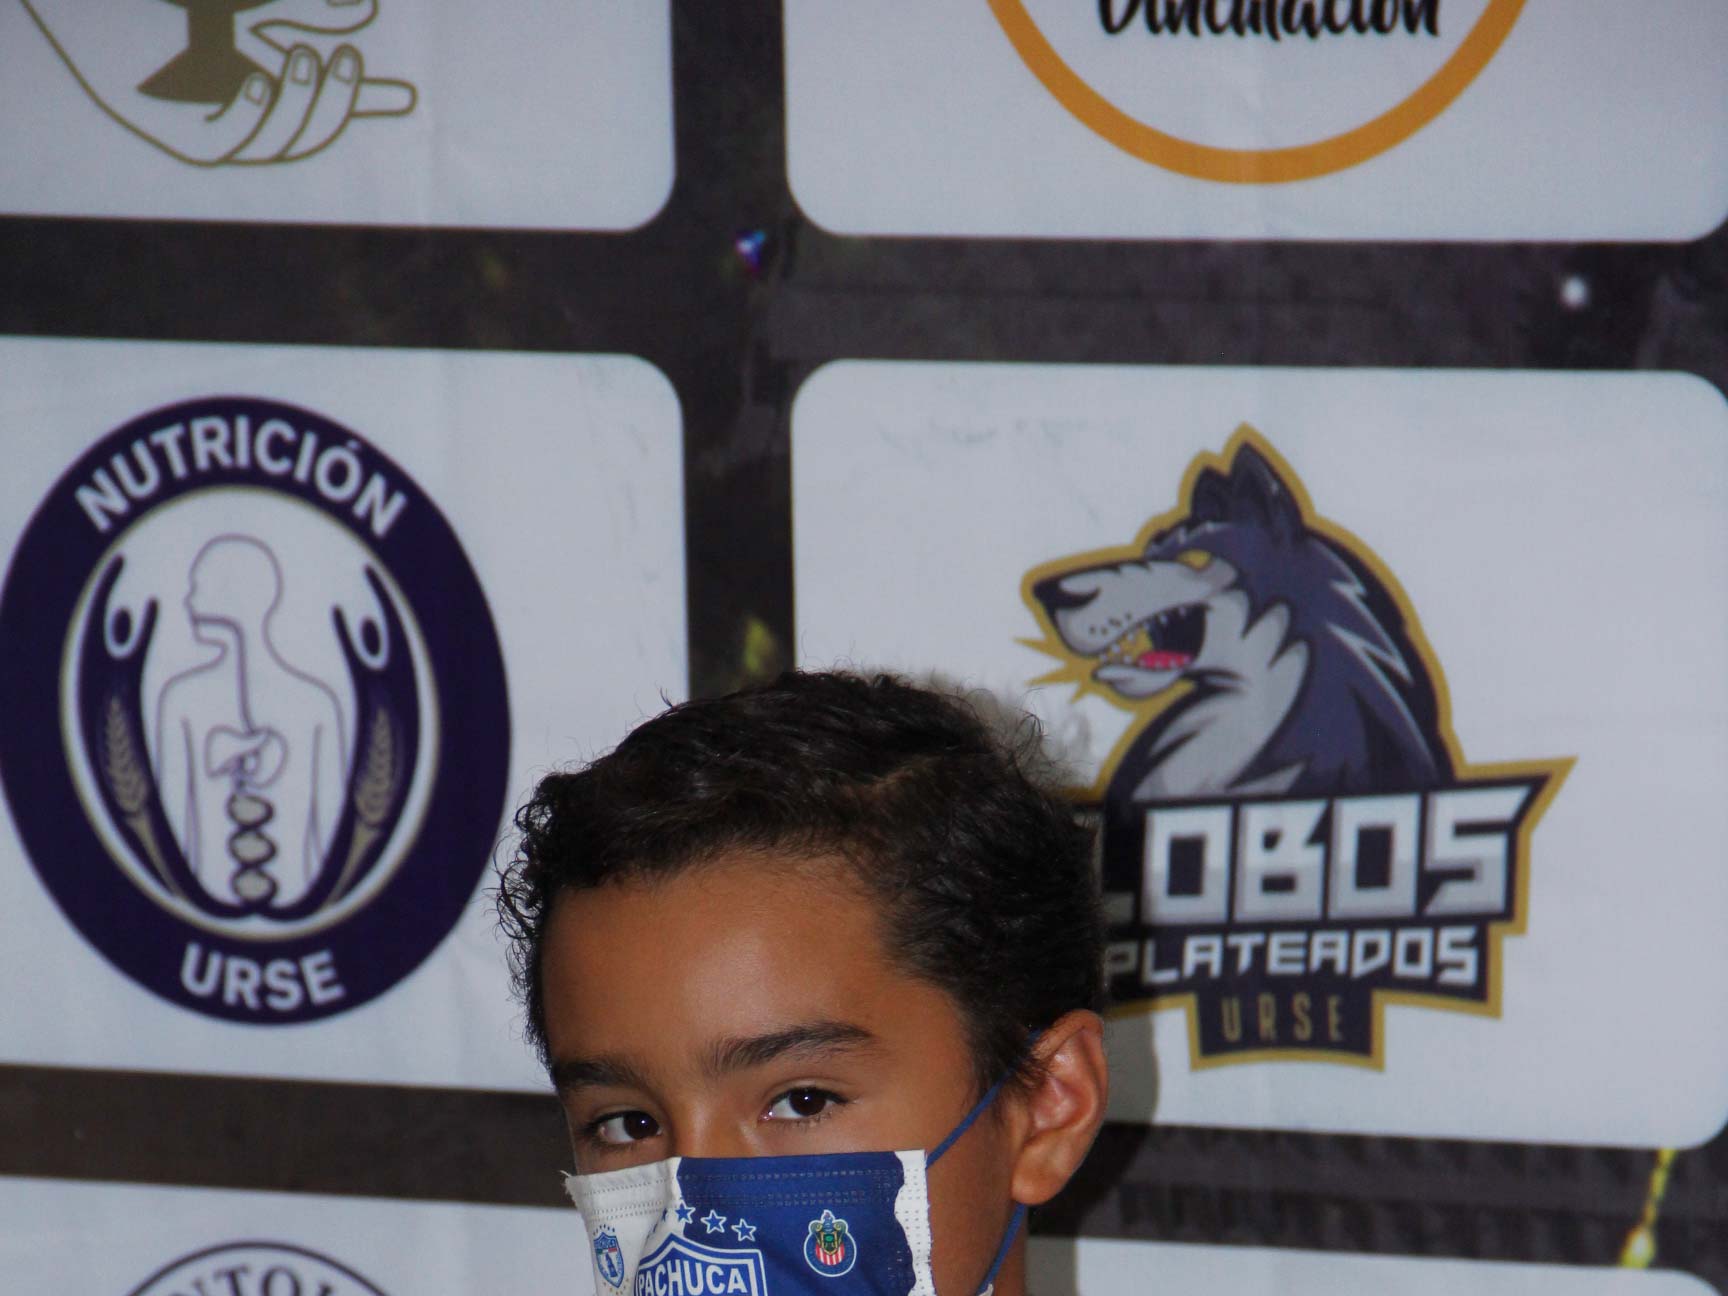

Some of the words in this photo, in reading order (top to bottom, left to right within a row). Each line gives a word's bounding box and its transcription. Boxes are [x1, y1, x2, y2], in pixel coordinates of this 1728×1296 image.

[75, 414, 407, 537] NUTRICIÓN
[1106, 785, 1531, 926] OBOS
[180, 943, 344, 1010] URSE
[1105, 925, 1479, 986] PLATEADOS
[1221, 992, 1343, 1042] URSE
